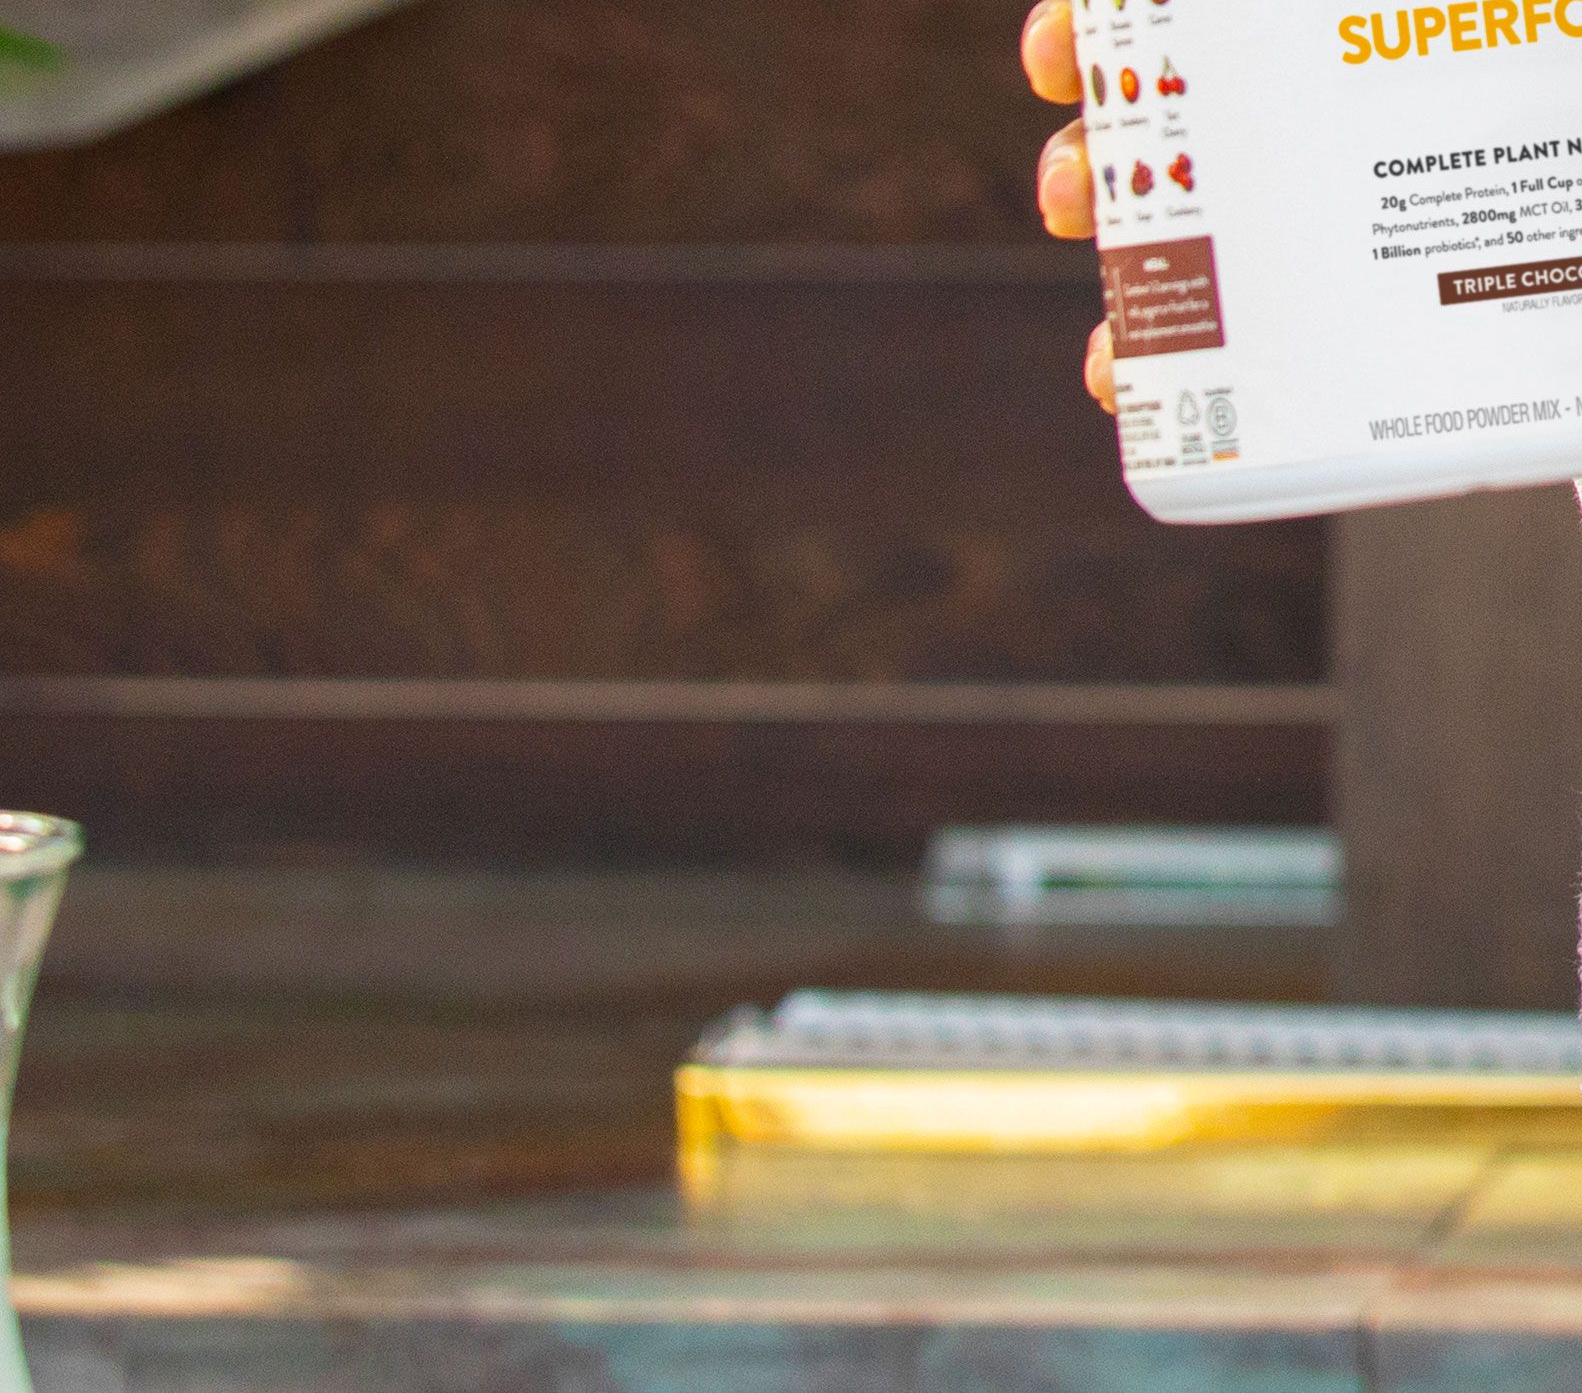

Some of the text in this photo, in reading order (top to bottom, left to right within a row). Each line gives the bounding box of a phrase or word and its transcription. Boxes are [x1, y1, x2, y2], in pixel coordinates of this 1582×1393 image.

[1373, 149, 1487, 178] COMPLETE
[1493, 141, 1560, 164] PLANT
[1381, 195, 1407, 212] 20g
[1409, 190, 1462, 207] Complete
[1465, 184, 1509, 199] Protein,
[1511, 182, 1517, 194] 1
[1520, 178, 1544, 193] Full
[1547, 176, 1573, 191] Cup
[1372, 217, 1459, 238] Phytonutrients,
[1462, 209, 1517, 225] 2800mg
[1520, 203, 1548, 217] MCT
[1551, 200, 1573, 214] Oil,
[1372, 248, 1378, 260] 1
[1381, 244, 1421, 259] Billion
[1484, 234, 1504, 247] and
[1507, 231, 1523, 244] 50
[1526, 229, 1556, 242] other
[1453, 273, 1517, 295] TRIPLE
[1502, 296, 1550, 313] NATURALLY
[1369, 415, 1422, 441] WHOLE
[1425, 411, 1464, 435] FOOD
[1467, 402, 1530, 430] POWDER
[1532, 398, 1562, 421] MIX
